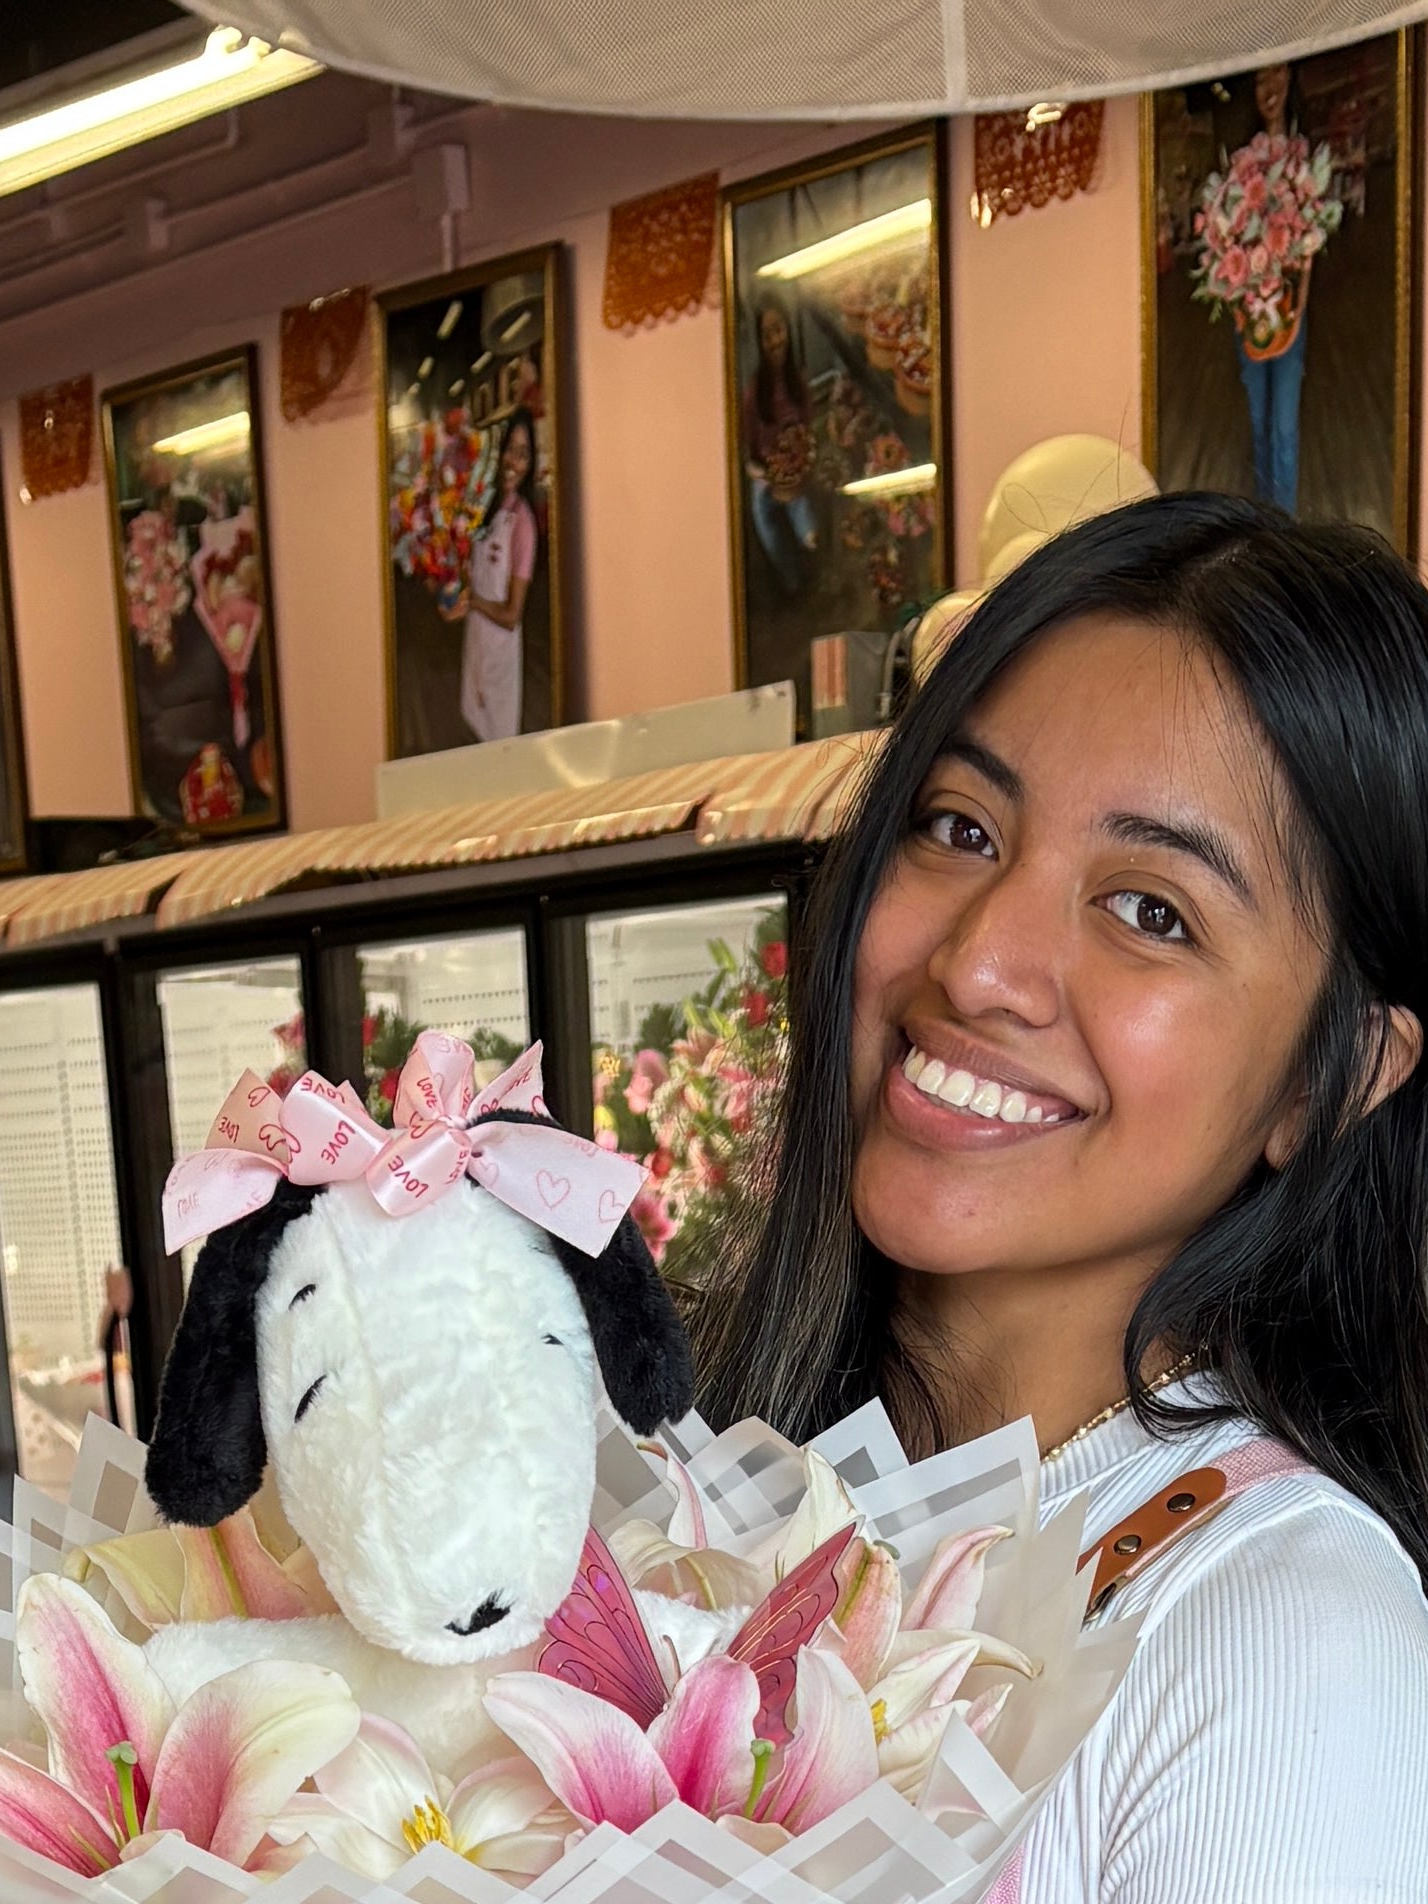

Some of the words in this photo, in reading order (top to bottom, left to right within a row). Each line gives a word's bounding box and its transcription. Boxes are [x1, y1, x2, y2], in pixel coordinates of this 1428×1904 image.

[300, 1076, 346, 1105] LOVE
[321, 1119, 356, 1165] LOVE
[387, 1155, 430, 1199] LOVE
